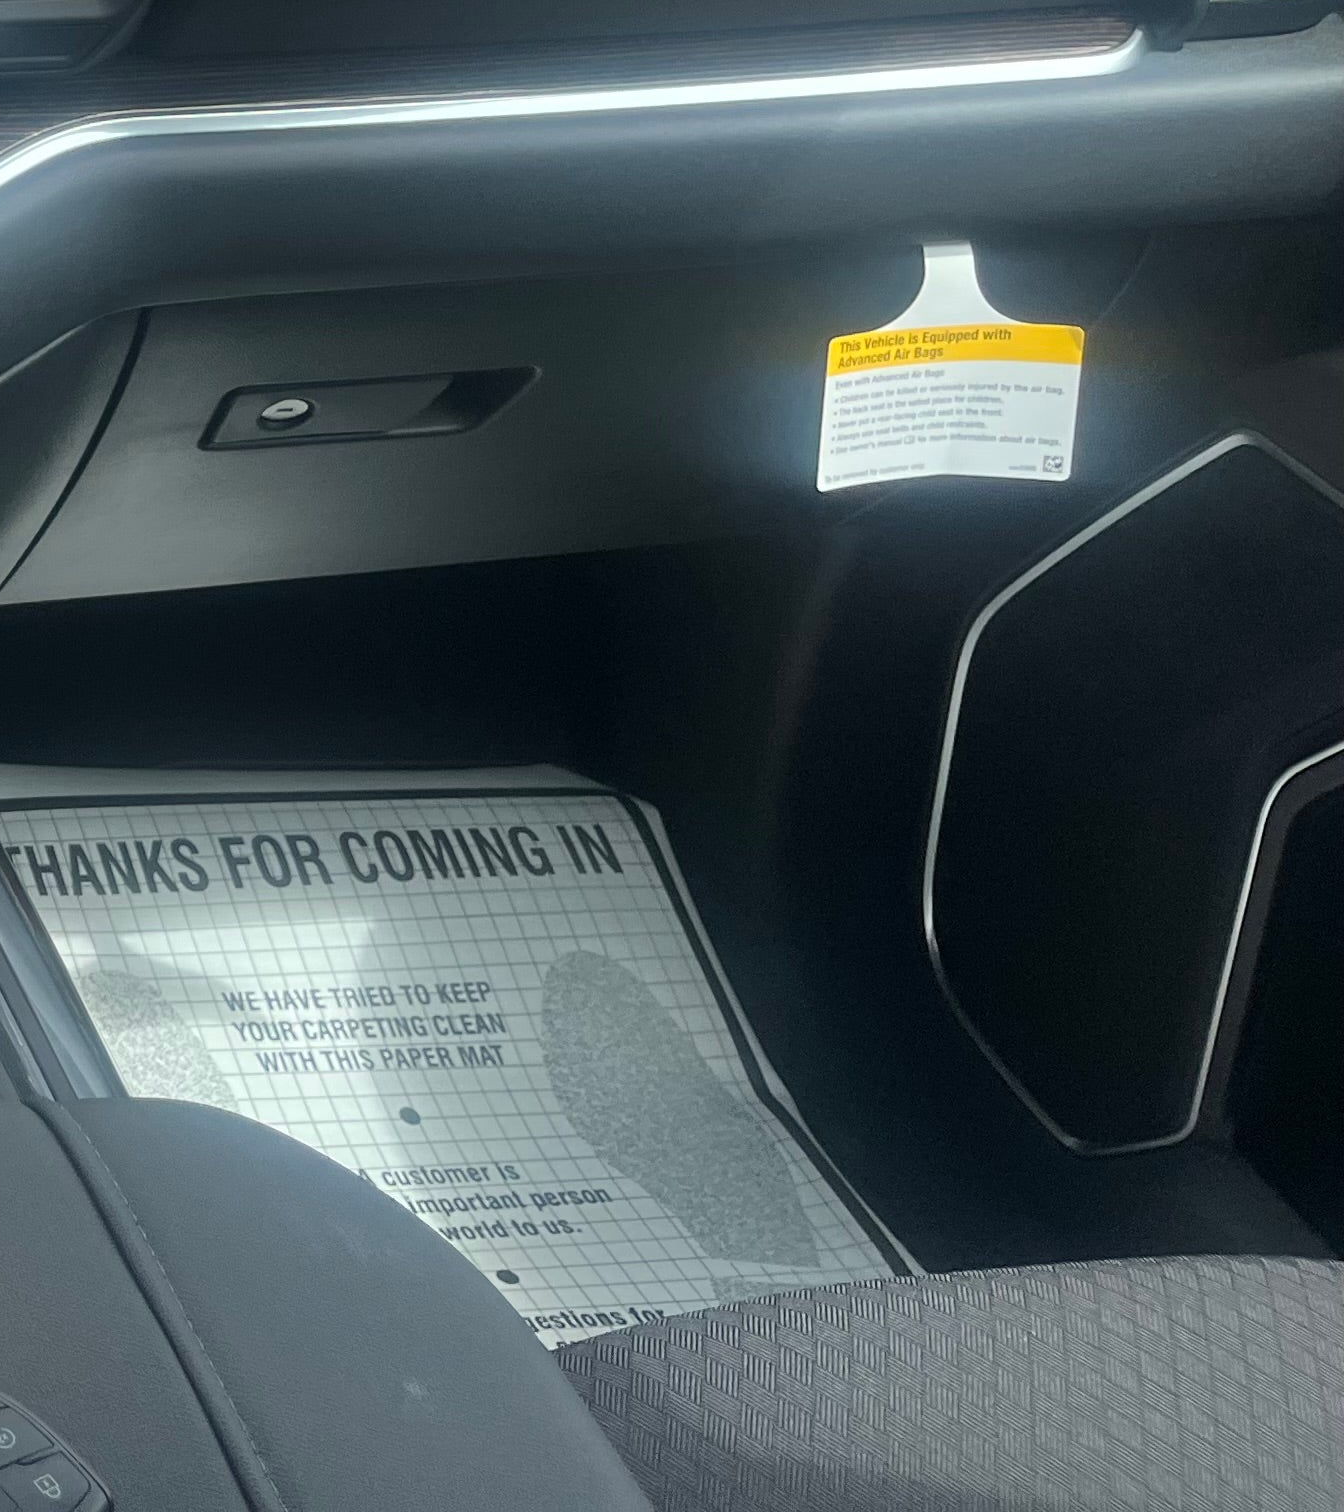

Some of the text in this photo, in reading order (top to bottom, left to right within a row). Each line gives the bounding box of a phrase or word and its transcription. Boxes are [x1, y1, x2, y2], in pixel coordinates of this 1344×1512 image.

[840, 330, 1011, 353] This Vehicle is Equipped with
[838, 347, 944, 369] Advanced Air Bags
[211, 834, 333, 888] FOR
[338, 825, 554, 884] COMING
[555, 824, 623, 874] IN
[222, 982, 491, 1012] WE HAVE TRIED TO KEEP
[232, 1013, 506, 1042] YOUR CARPETING CLEAN
[256, 1045, 505, 1072] WITH THIS PAPER MAT
[382, 1164, 490, 1187] customer
[494, 1162, 520, 1181] is
[407, 1189, 613, 1217] important person
[439, 1218, 582, 1240] world to us.
